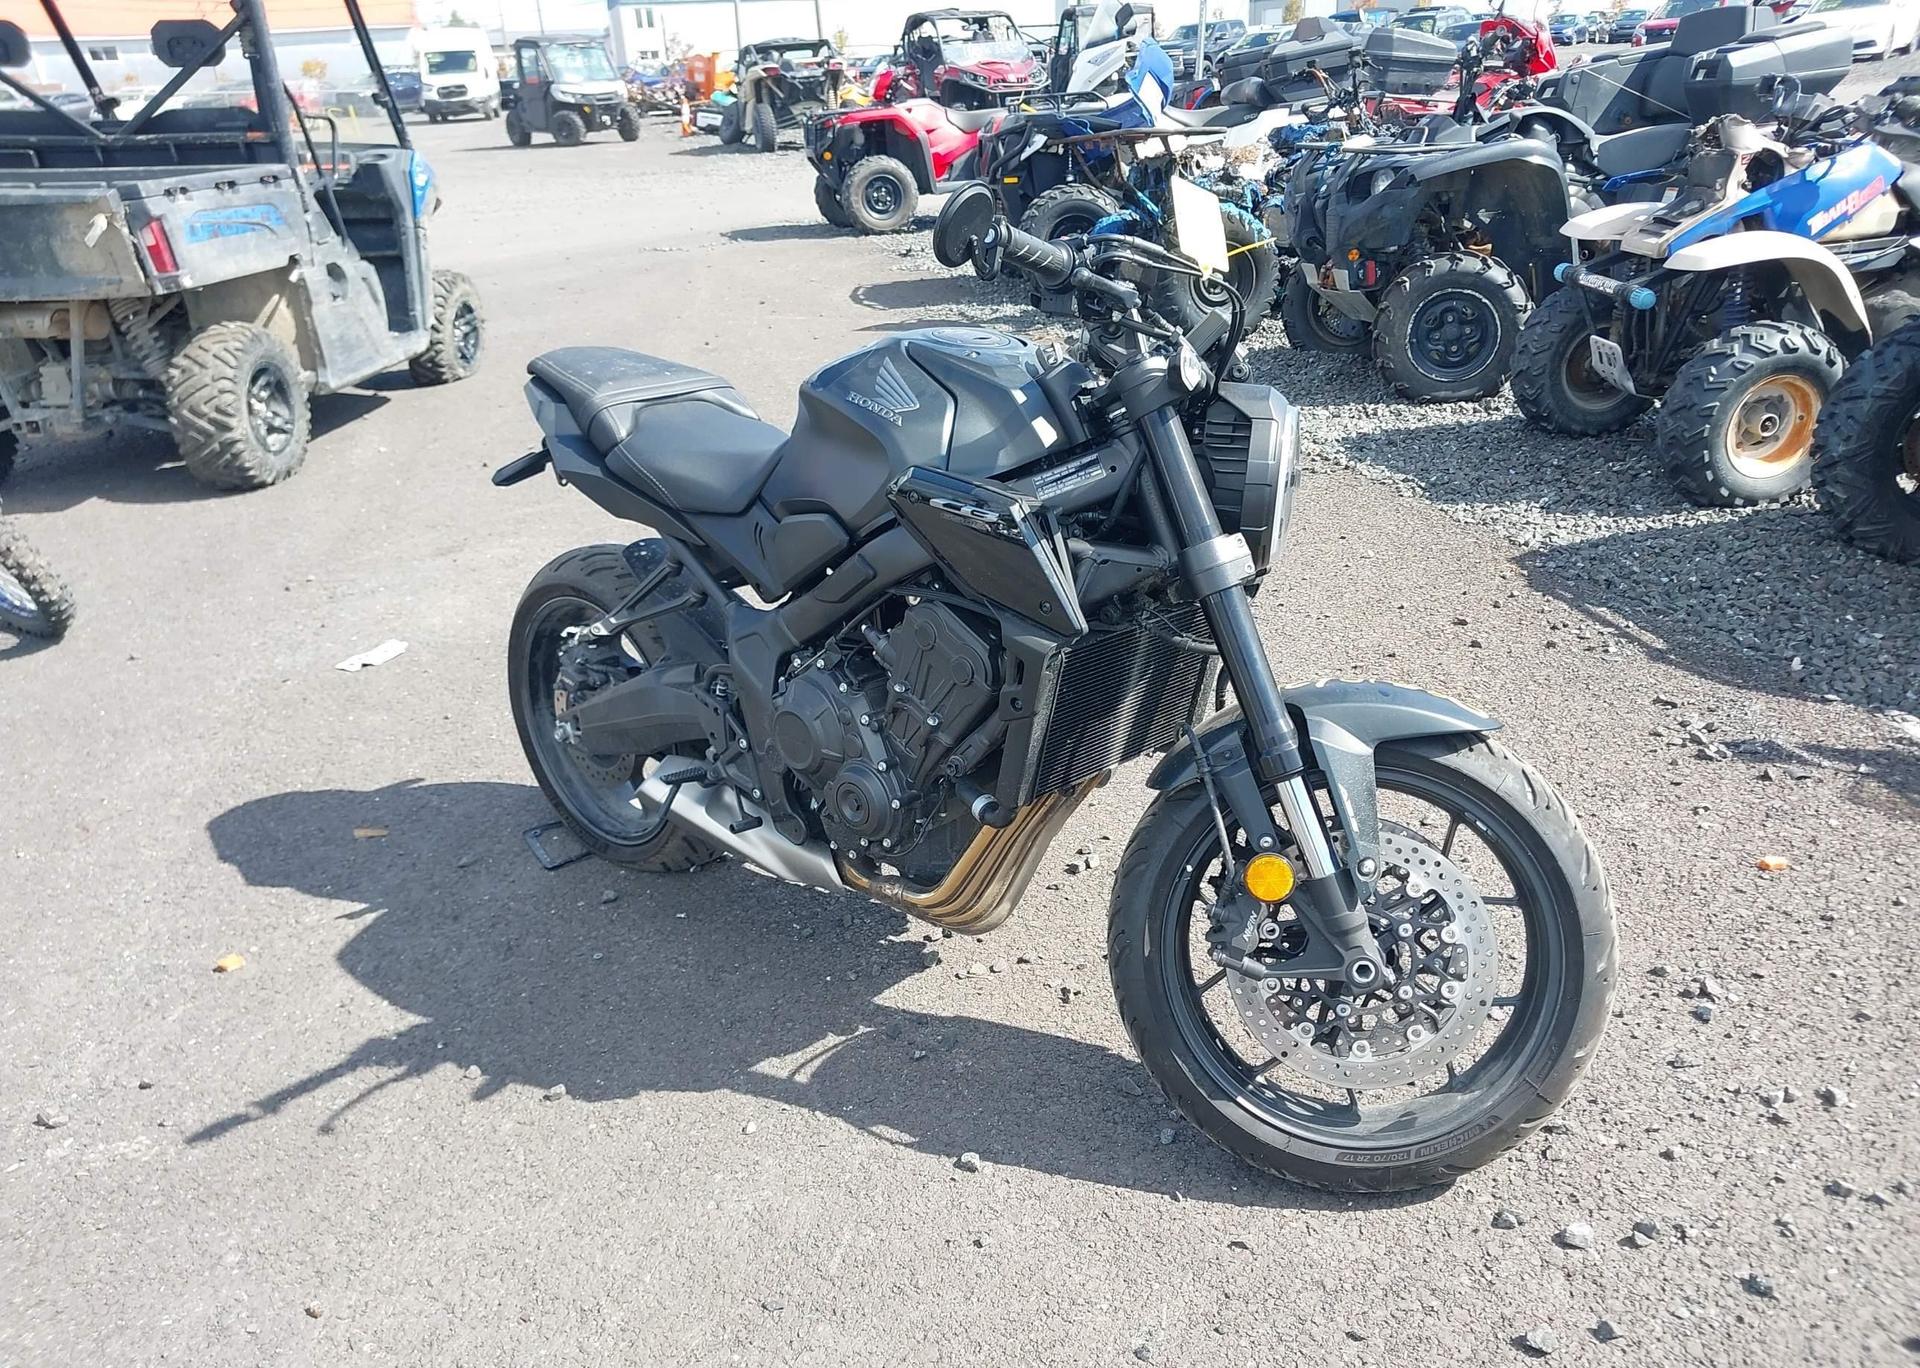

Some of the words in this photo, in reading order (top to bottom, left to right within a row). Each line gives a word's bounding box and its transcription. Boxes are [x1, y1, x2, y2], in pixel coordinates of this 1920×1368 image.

[846, 391, 902, 427] HONDA
[1420, 1127, 1481, 1157] MICHELIN
[1343, 1153, 1354, 1162] 17
[1356, 1154, 1371, 1162] ZR
[1373, 1152, 1409, 1163] 120/70
